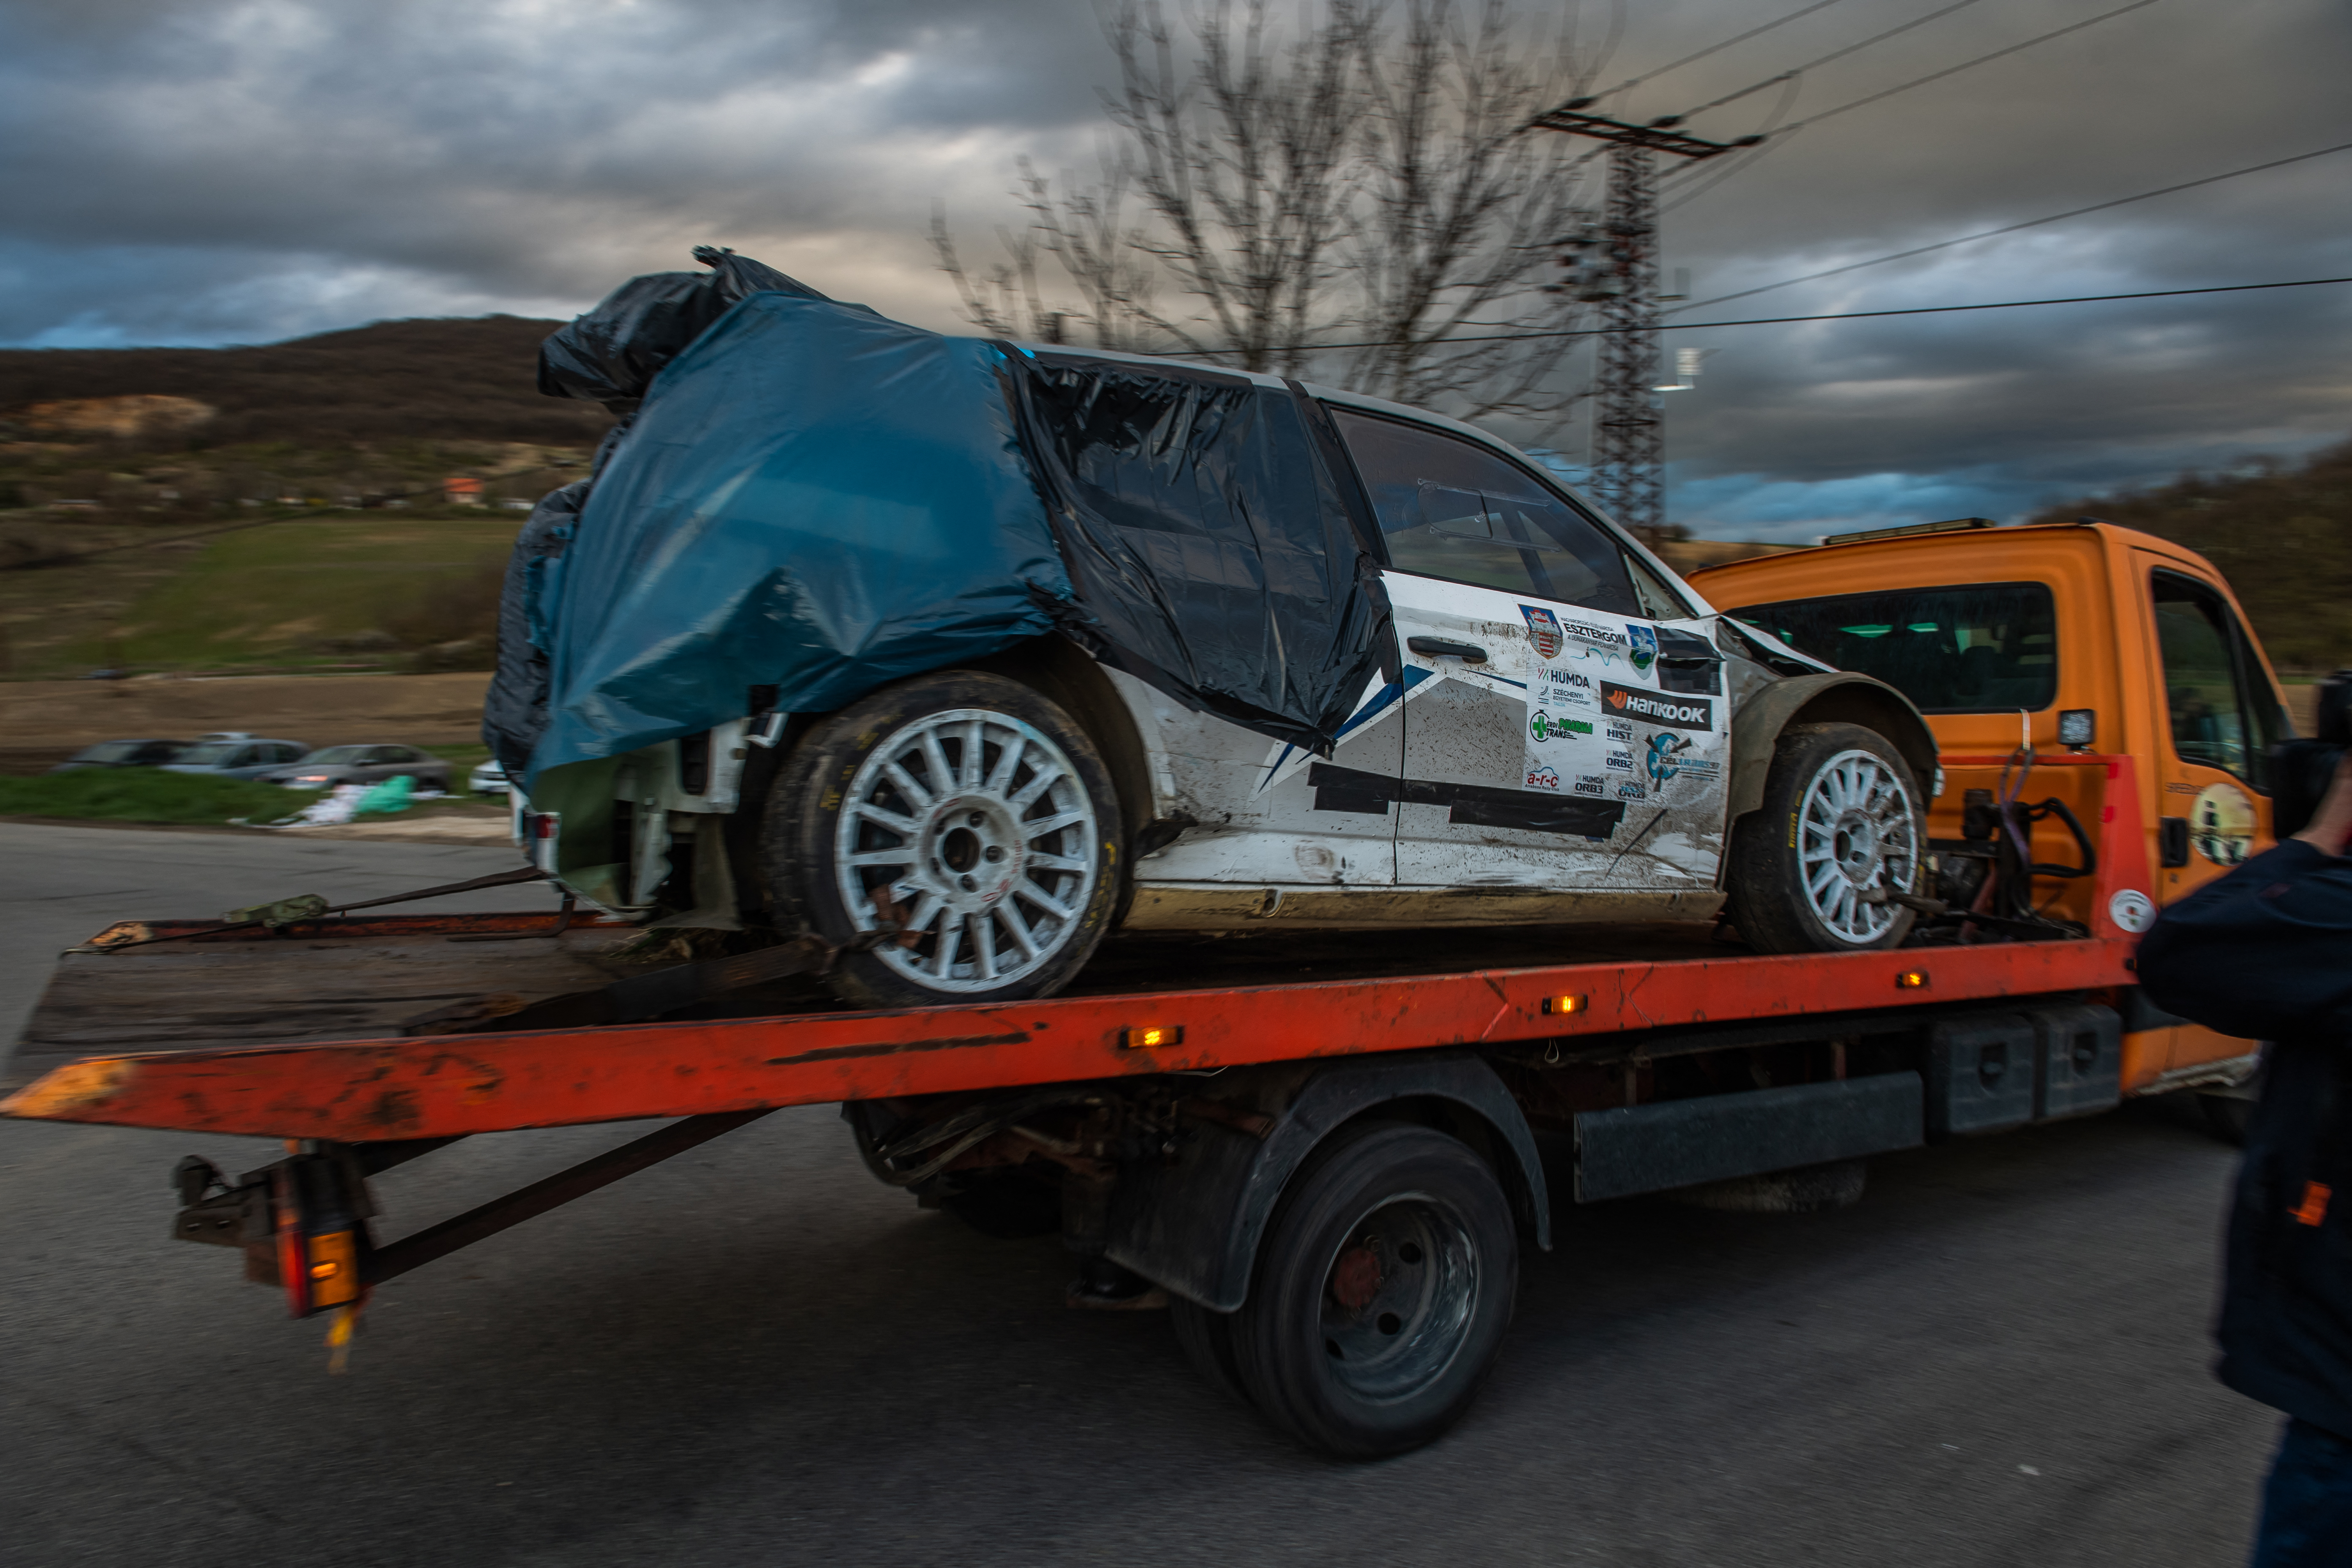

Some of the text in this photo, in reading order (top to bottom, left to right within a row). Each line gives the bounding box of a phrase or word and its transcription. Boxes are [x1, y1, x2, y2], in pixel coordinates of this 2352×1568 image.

[1563, 623, 1628, 645] ESZTERGOM
[1551, 670, 1590, 689] HUMDA
[1553, 688, 1584, 700] SZÉCHENYI
[1546, 718, 1593, 735] ÉRDI PHARMA
[1546, 728, 1567, 739] TRANS
[1606, 728, 1633, 740] HIST
[1606, 757, 1633, 769] ORB2
[1582, 775, 1604, 784] HUMDA
[1575, 782, 1604, 794] ORB3
